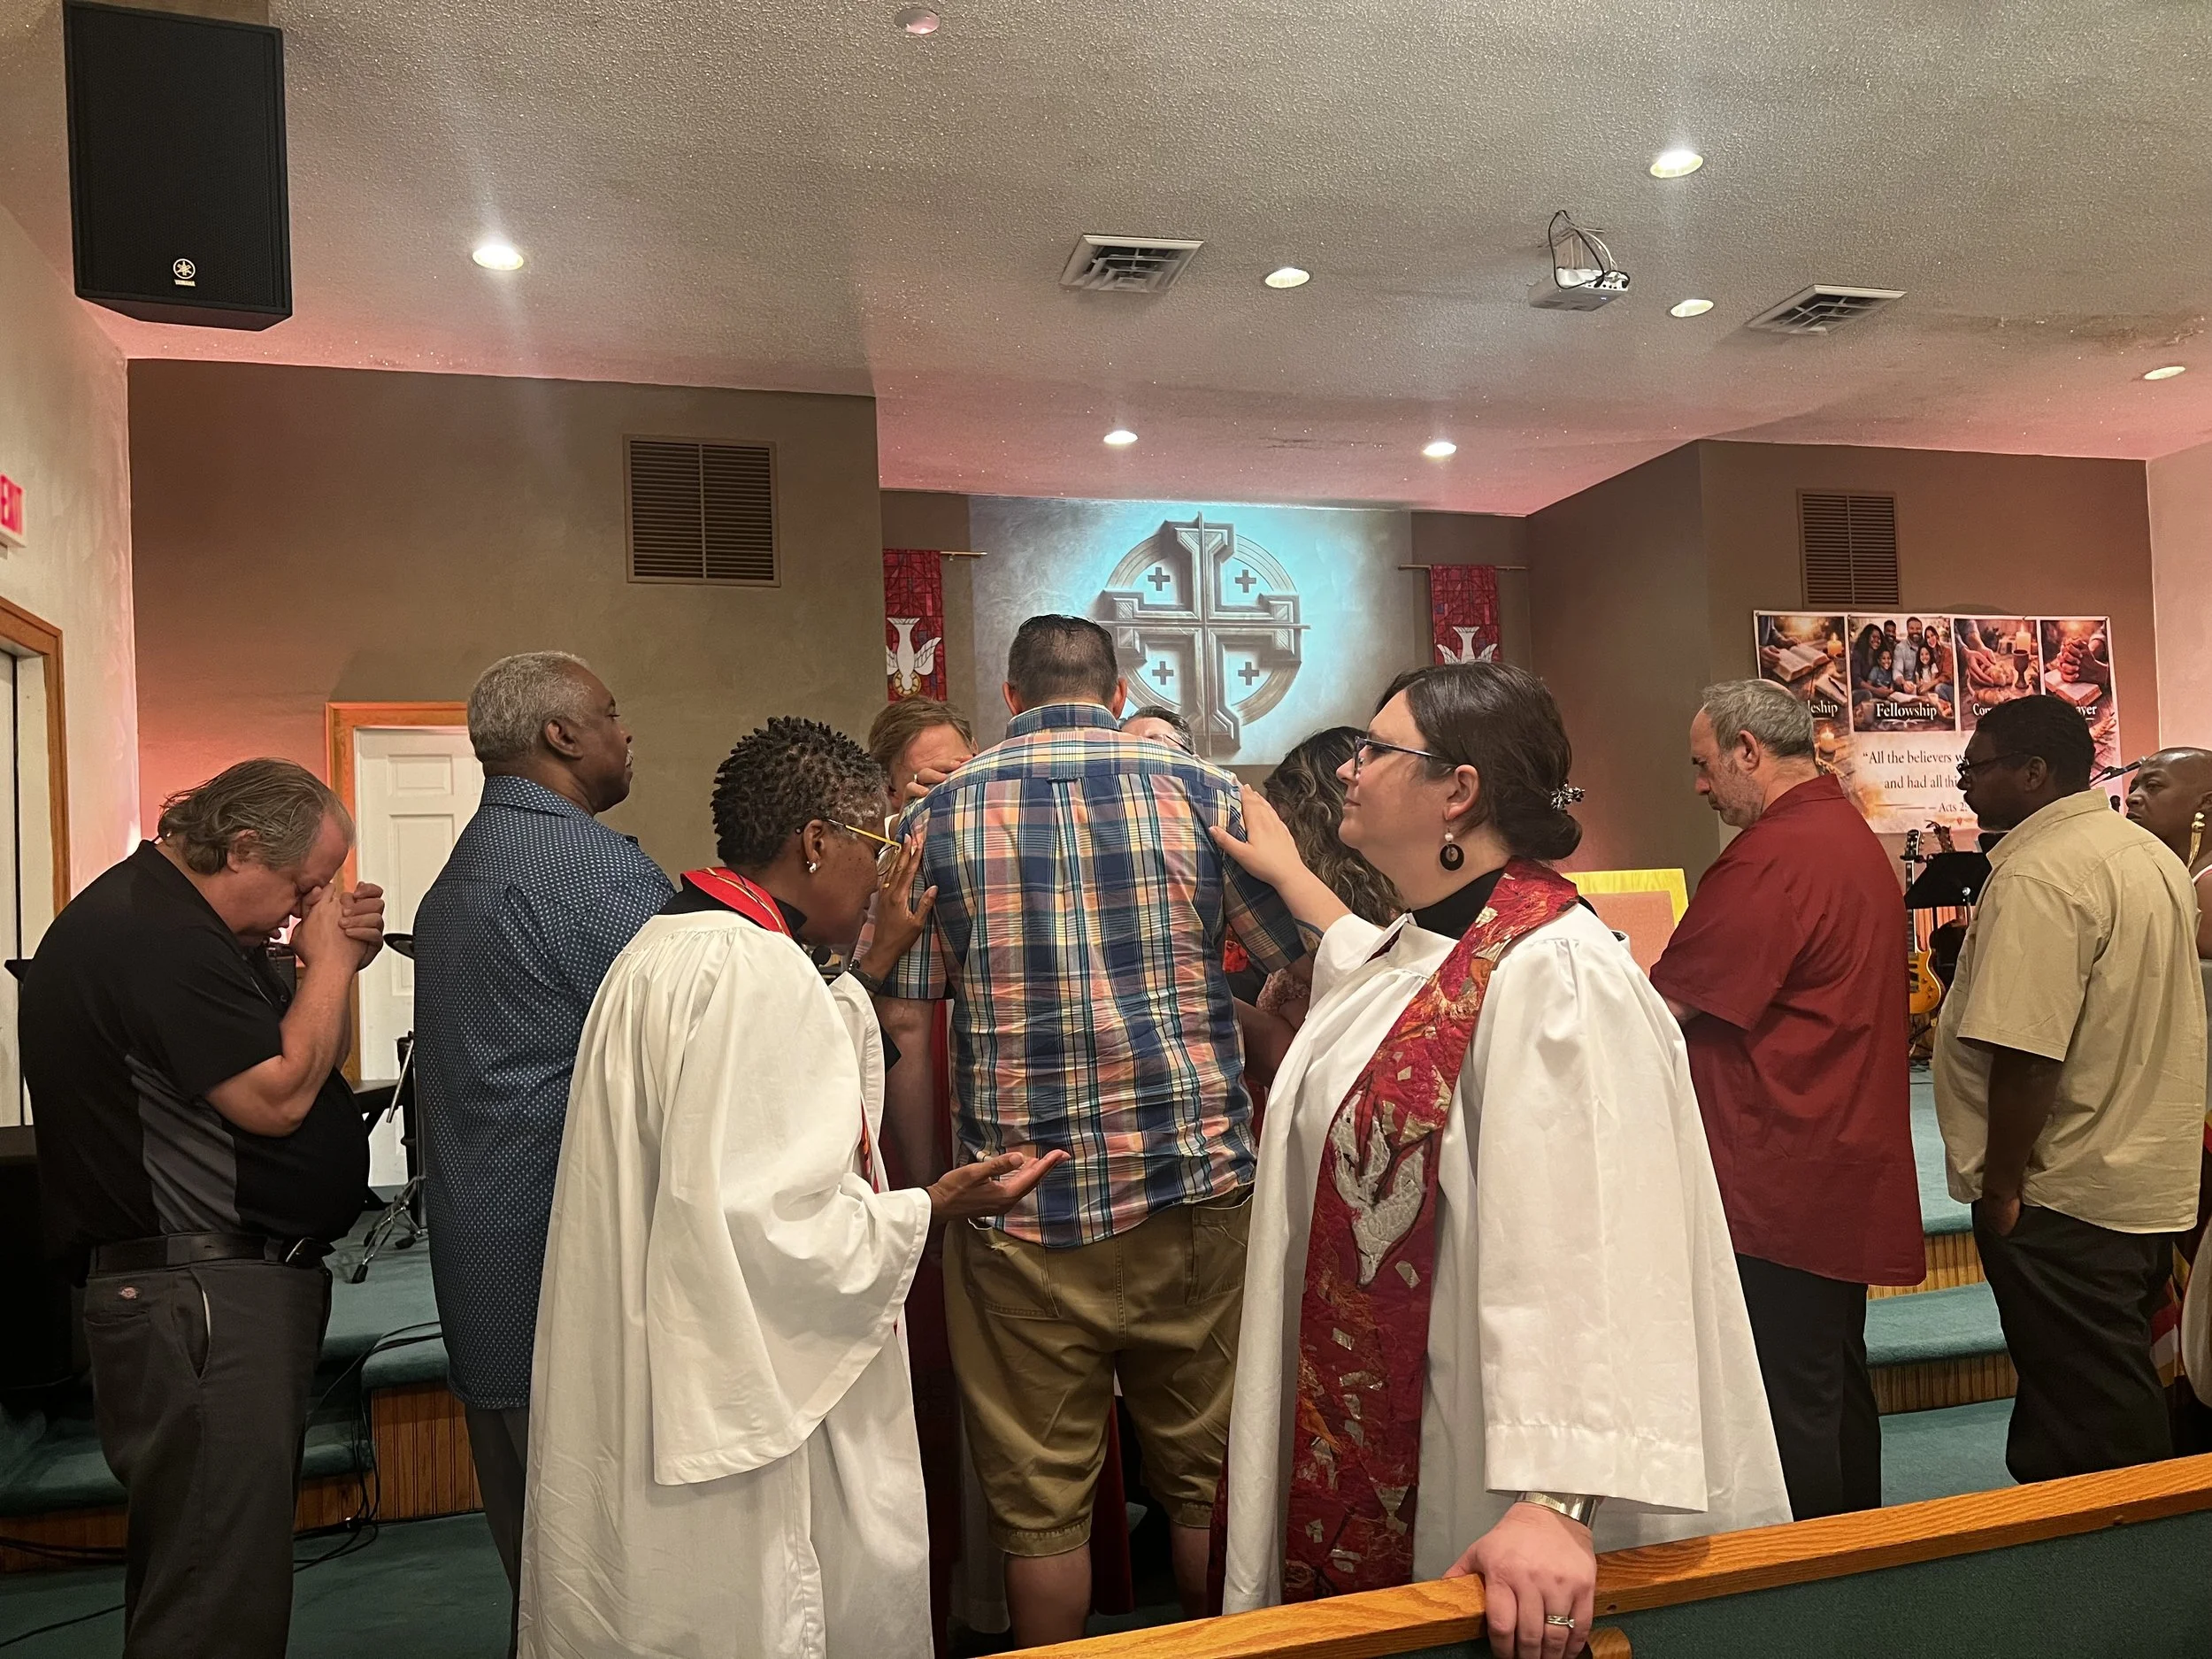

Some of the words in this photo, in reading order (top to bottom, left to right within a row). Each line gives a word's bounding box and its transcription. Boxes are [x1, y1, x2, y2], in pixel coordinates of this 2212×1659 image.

[1808, 699, 1839, 717] leship
[1876, 703, 1938, 720] Fellowship
[2075, 704, 2098, 717] ayer
[1887, 750, 1904, 764] the
[1907, 749, 1952, 764] believers
[1884, 775, 1904, 789] and
[1907, 774, 1927, 788] had
[1930, 774, 1943, 787] all
[1945, 775, 1958, 787] thi
[1939, 802, 1957, 813] Acts
